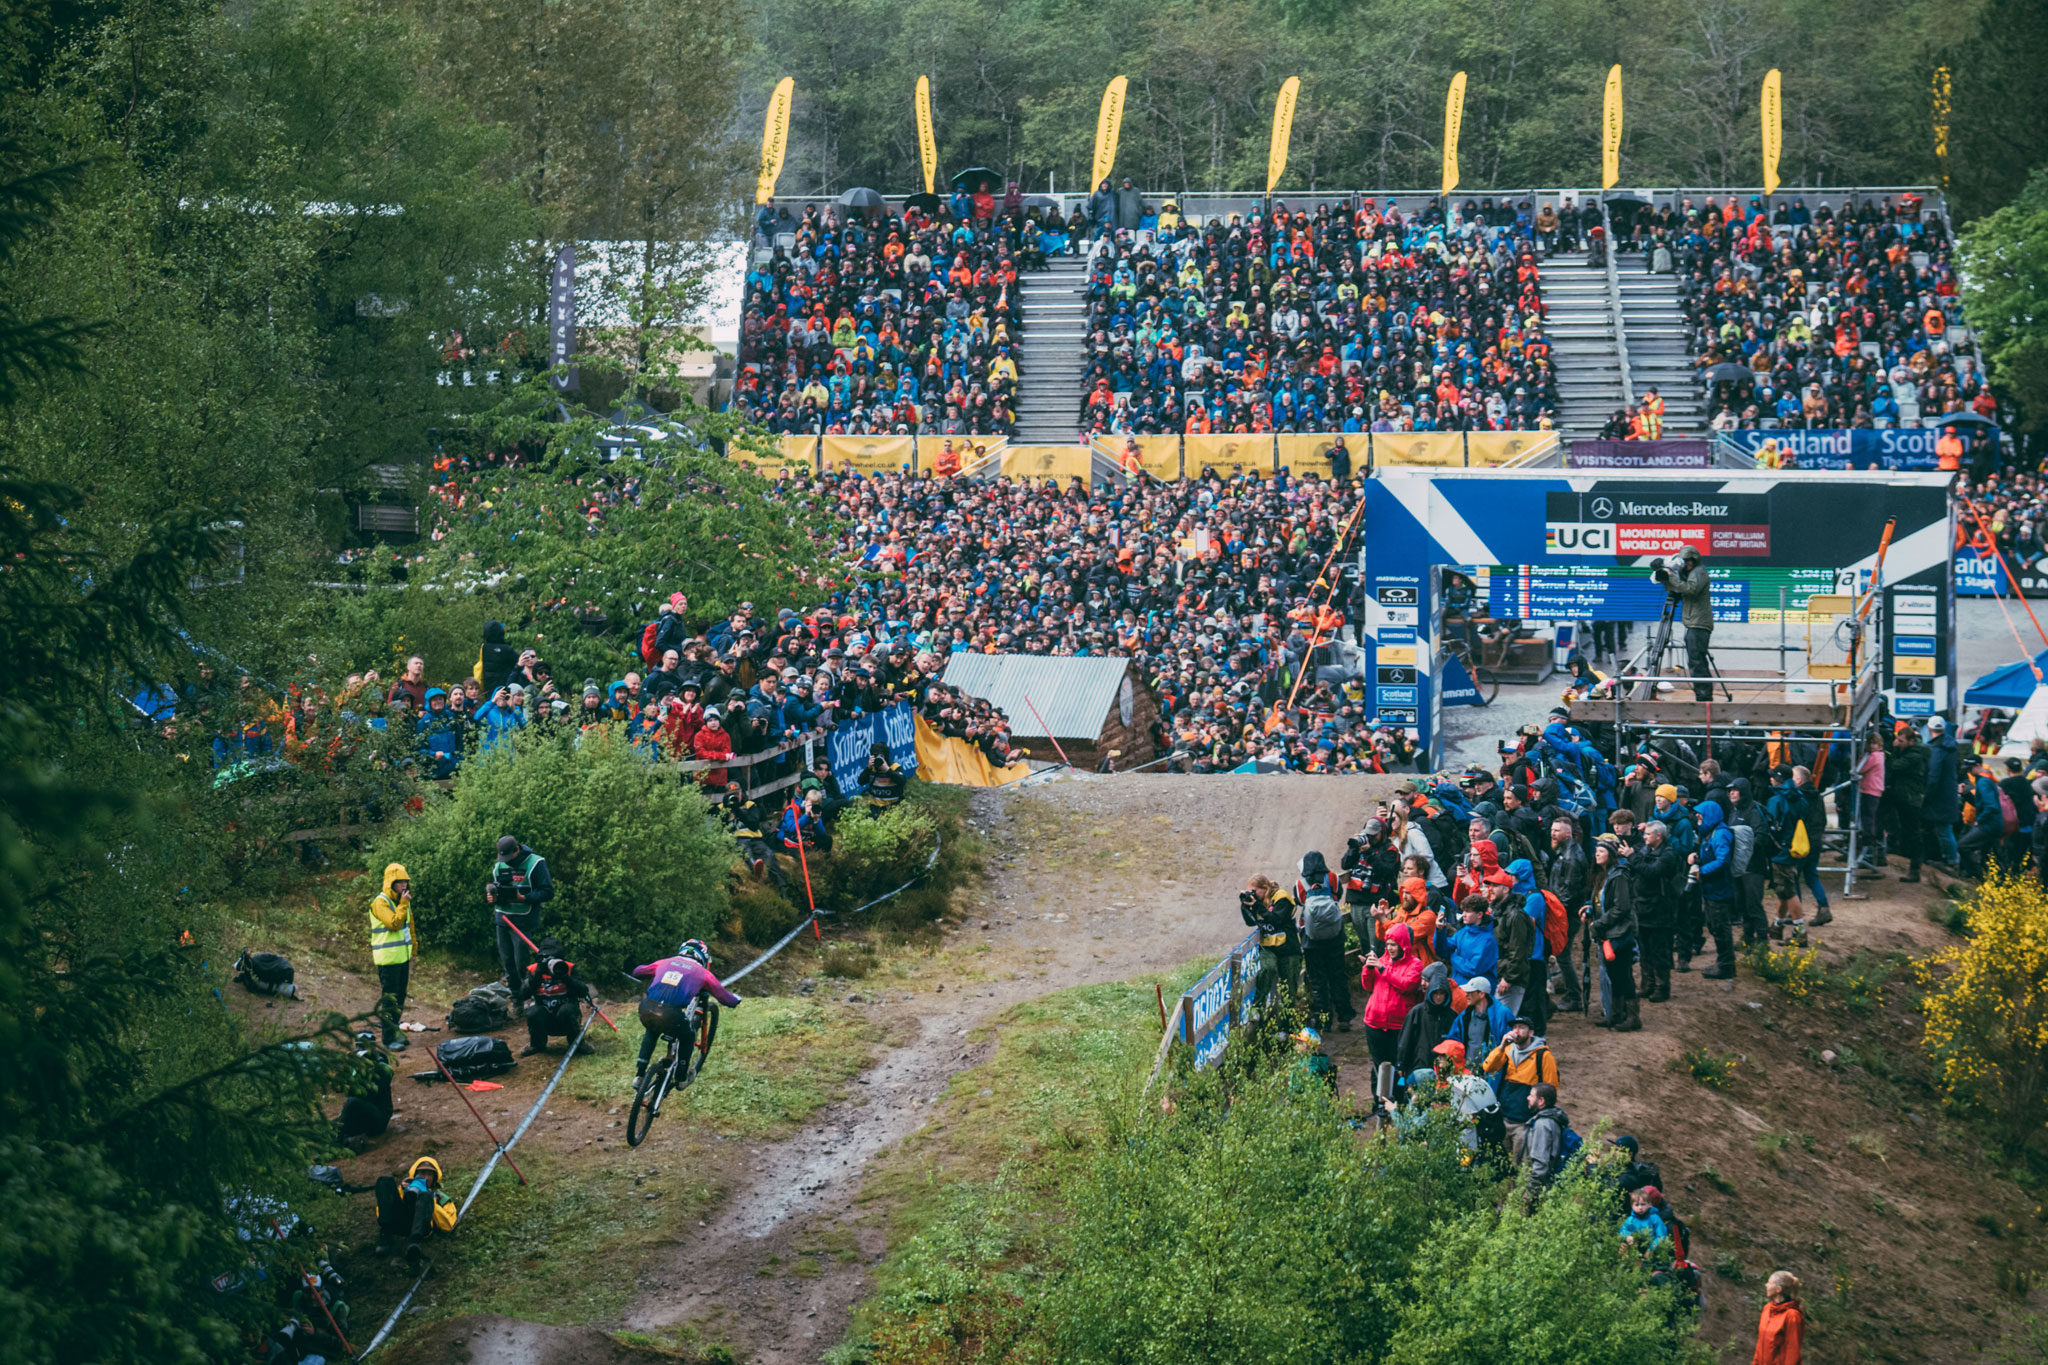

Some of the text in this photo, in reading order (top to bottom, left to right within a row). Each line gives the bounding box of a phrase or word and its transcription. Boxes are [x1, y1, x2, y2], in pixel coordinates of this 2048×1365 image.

[920, 92, 933, 165] Freewheel
[1100, 91, 1119, 164] Freewheel
[1747, 429, 1852, 455] Sotland
[1575, 455, 1705, 466] VISITSCOTLAND.COM
[1619, 501, 1729, 516] Mercedes-Benz
[1558, 528, 1610, 549] UCI
[1619, 528, 1705, 539] MOUNTAIN BIKE
[1713, 531, 1765, 540] FORT WILLIAM
[1619, 540, 1684, 550] WORLD CUP
[1713, 540, 1767, 549] GREAT BRITAIN
[1382, 689, 1413, 698] Scotland
[1443, 687, 1476, 699] IMANO
[883, 702, 914, 749] Scotla
[833, 712, 876, 770] Scotland
